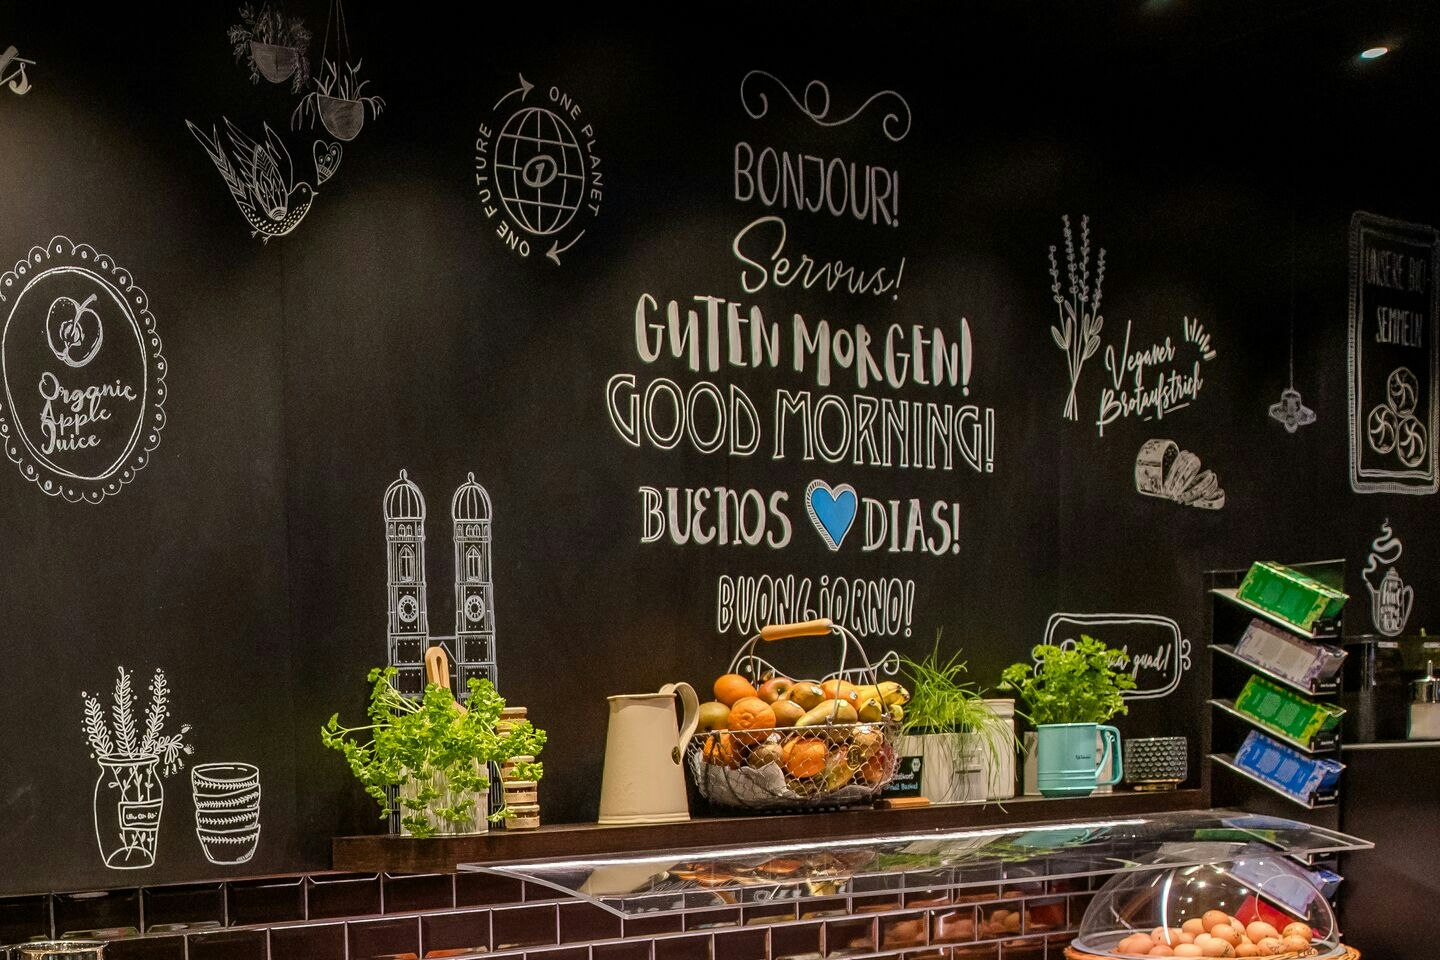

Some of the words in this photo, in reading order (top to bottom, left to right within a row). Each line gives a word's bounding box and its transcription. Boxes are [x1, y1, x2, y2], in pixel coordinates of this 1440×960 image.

[475, 122, 498, 219] FUTURE
[549, 86, 582, 121] ONE
[581, 123, 604, 217] PLANET
[734, 141, 900, 228] BONJOUR!
[496, 220, 531, 257] ONE
[732, 216, 906, 301] Servus!
[635, 293, 779, 372] GUTEN
[793, 313, 973, 397] MORGEN!
[1105, 320, 1176, 390] Veganer
[1375, 305, 1423, 349] SEMMELN
[38, 371, 137, 411] Organic
[40, 396, 111, 435] Apple
[606, 373, 761, 456] GOOD
[773, 388, 995, 473] MORNING!
[1096, 360, 1204, 438] Brotaufstrich
[41, 422, 101, 454] Juice
[638, 486, 793, 549] BUENOS
[861, 497, 961, 556] DIAS!
